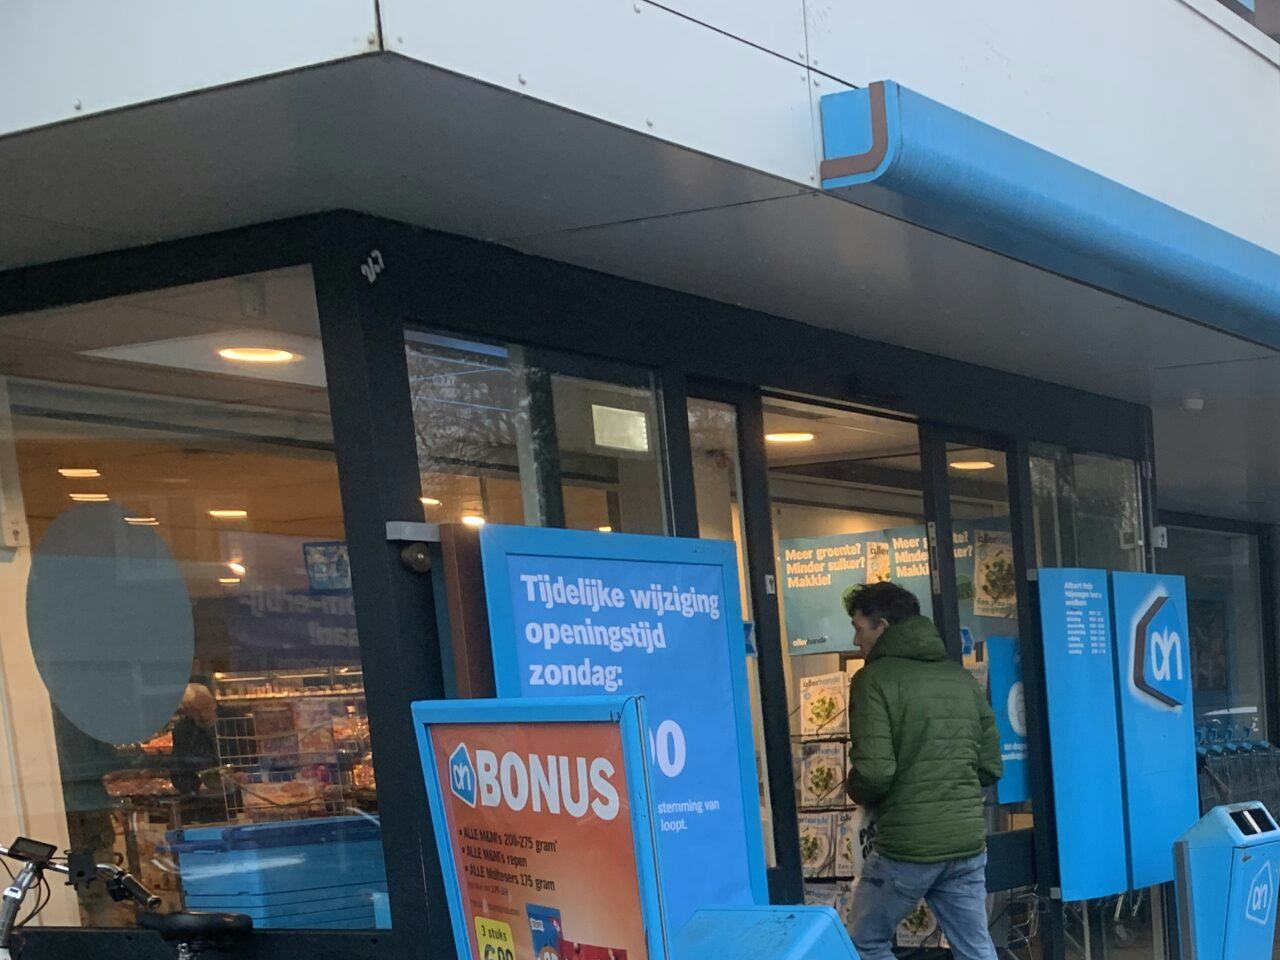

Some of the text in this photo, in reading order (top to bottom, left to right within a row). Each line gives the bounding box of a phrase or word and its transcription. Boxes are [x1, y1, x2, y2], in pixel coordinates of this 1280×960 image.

[893, 537, 919, 549] Meer
[785, 543, 861, 561] Meer groente?
[895, 550, 928, 563] Minde
[786, 557, 865, 574] Minder suiker?
[520, 573, 720, 620] Tijdelijke wijziging
[525, 618, 667, 654] openingstijd
[528, 657, 623, 693] zondag:
[475, 749, 620, 821] BONUS
[657, 799, 720, 814] stemming van
[661, 818, 688, 833] loopt.
[507, 855, 527, 868] repen
[520, 874, 533, 888] 175
[535, 879, 555, 891] gram
[481, 925, 507, 942] 3 stuks
